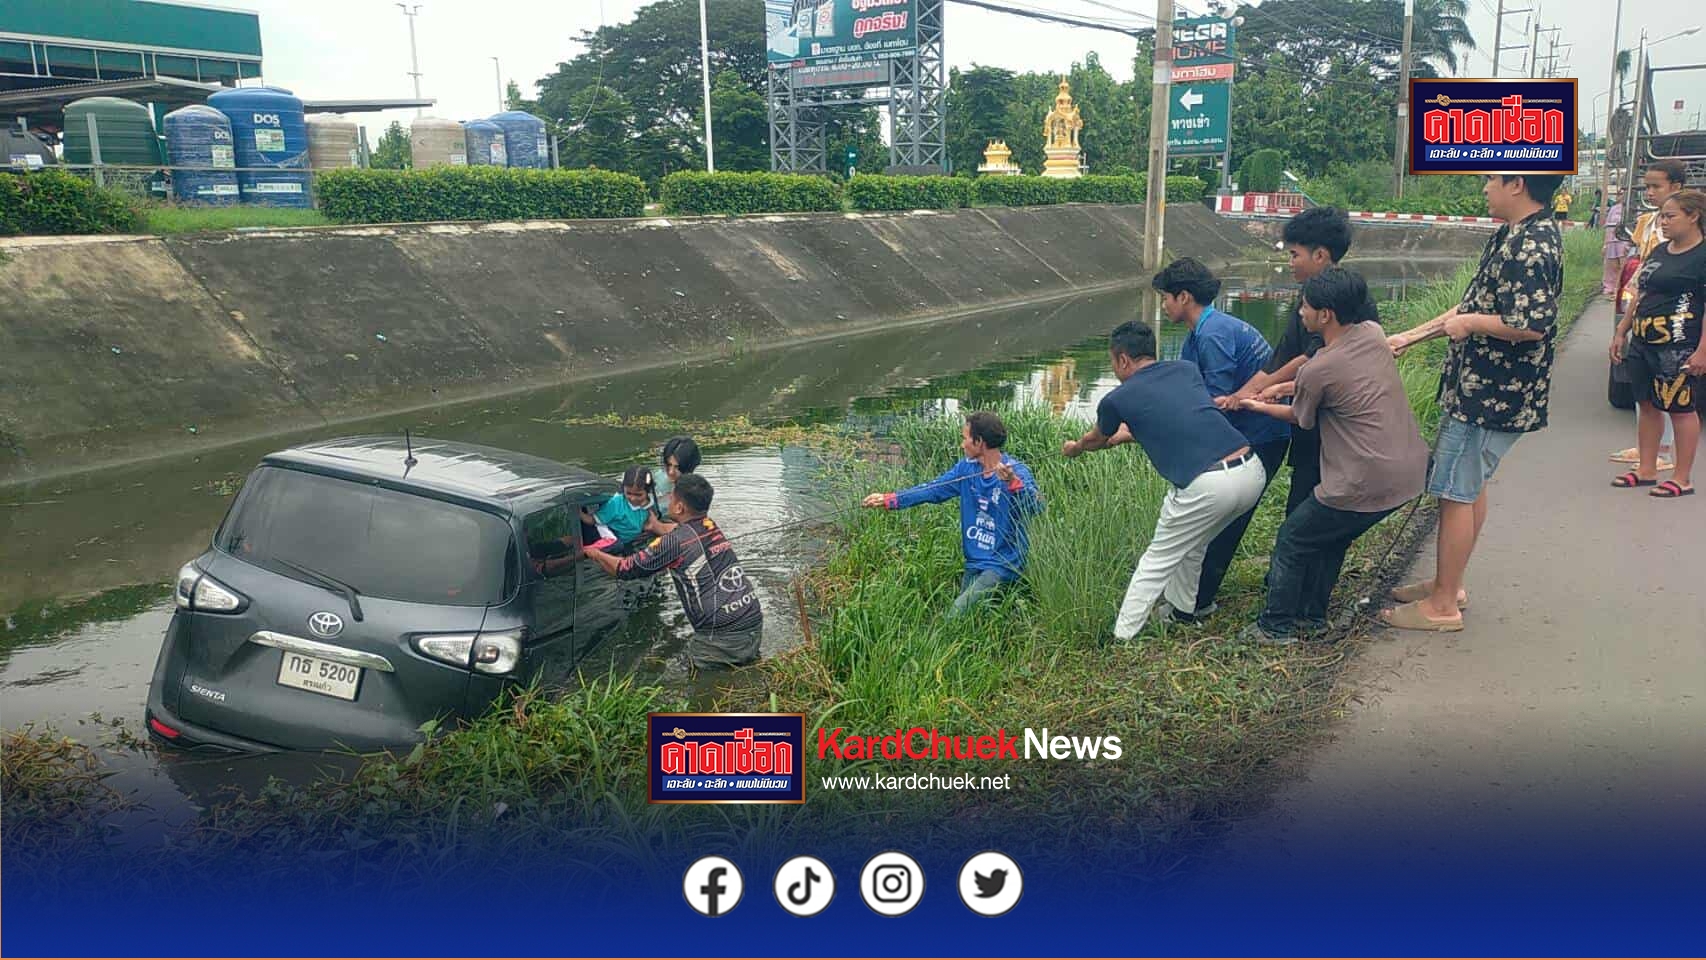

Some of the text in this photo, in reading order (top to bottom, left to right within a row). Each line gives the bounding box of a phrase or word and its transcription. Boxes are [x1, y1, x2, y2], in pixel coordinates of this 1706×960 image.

[853, 11, 908, 39] ถูกจริง!
[1171, 67, 1217, 79] มกาโฮม
[253, 113, 280, 124] DOS
[1171, 113, 1210, 129] ทางเข้า
[289, 656, 356, 684] กธ 5200
[189, 683, 226, 702] SIENTA
